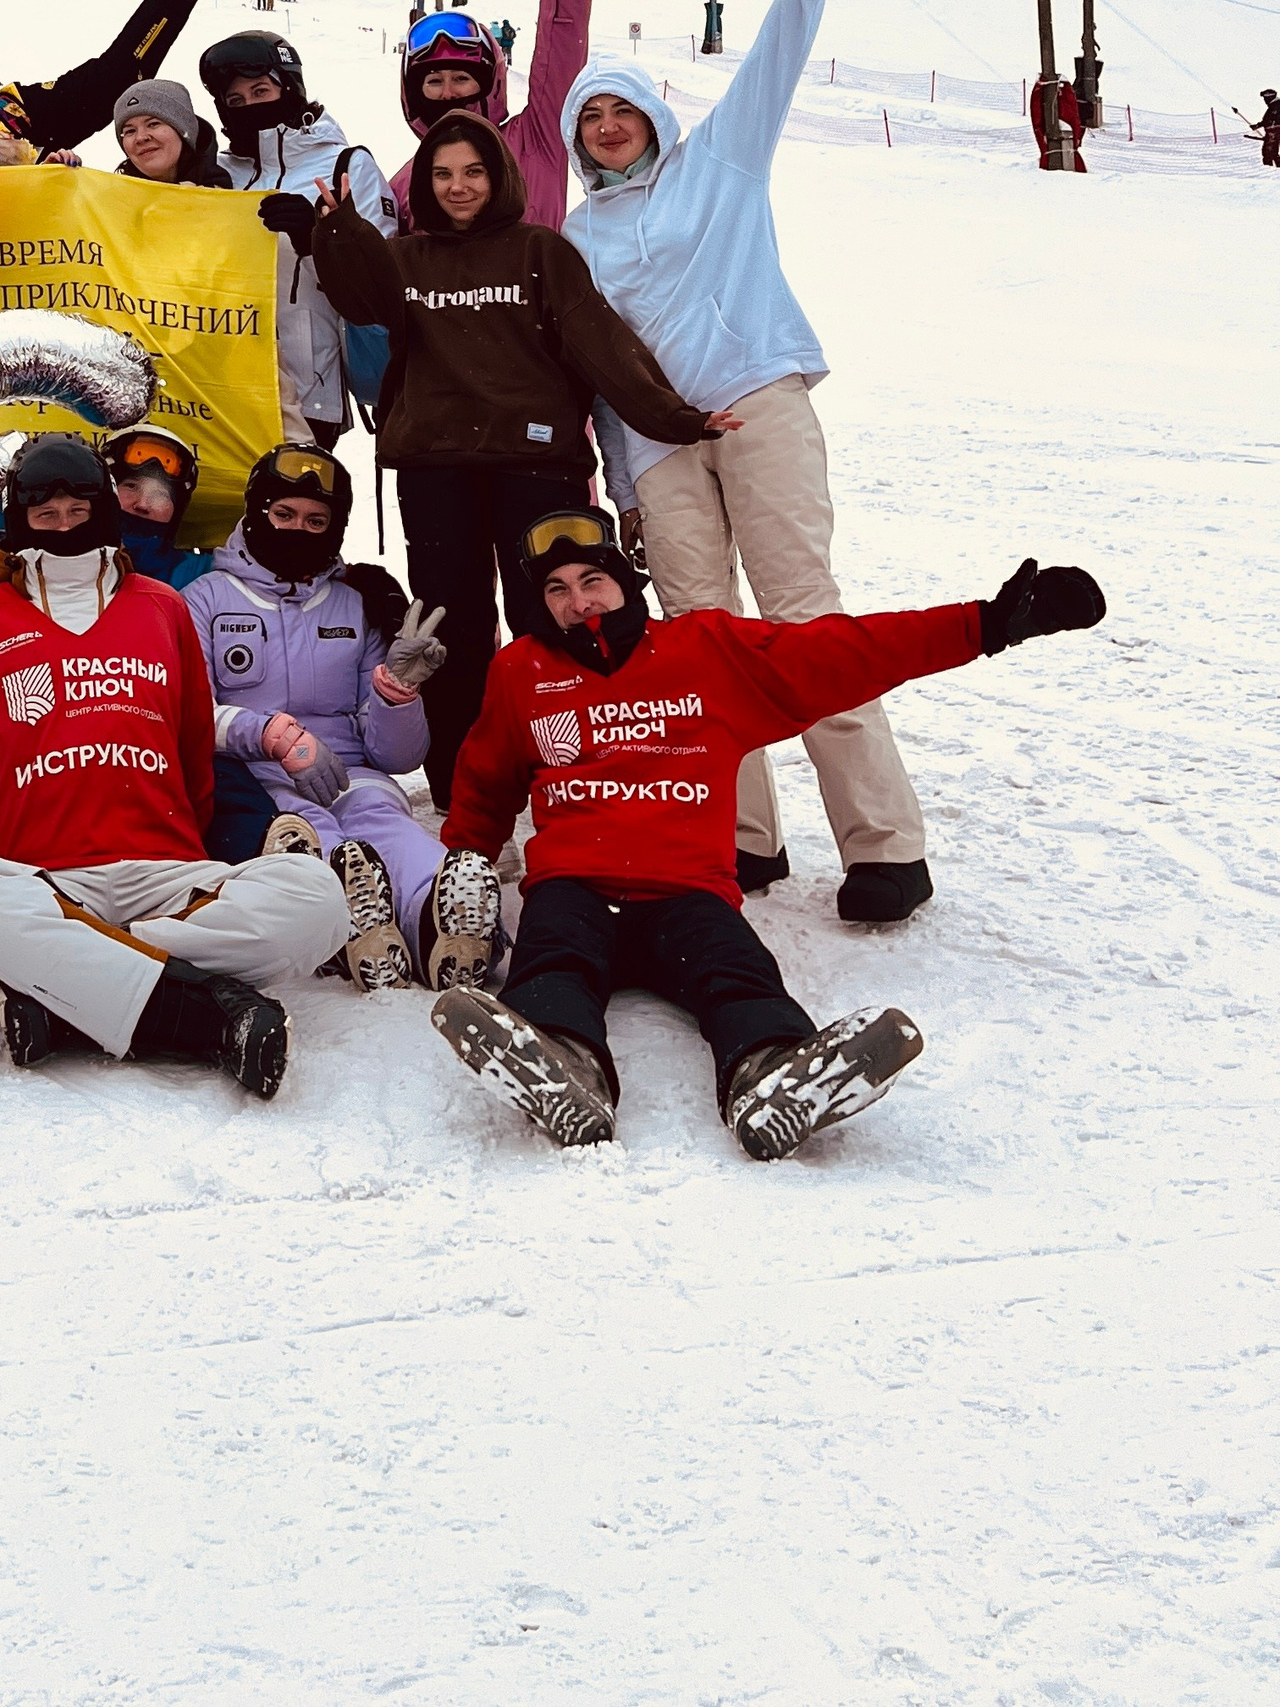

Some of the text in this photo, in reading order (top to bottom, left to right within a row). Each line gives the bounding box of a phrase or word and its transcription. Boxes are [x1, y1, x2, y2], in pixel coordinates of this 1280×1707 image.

[0, 281, 260, 336] ПРИКЛЮЧЕНИЙ
[220, 623, 257, 633] HIGHEXP
[62, 657, 167, 686] КРАСНЫЙ
[65, 678, 134, 702] КЛЮЧ
[65, 707, 92, 718] ЦЕНТР
[93, 702, 140, 715] АКТИВНОГО
[588, 693, 703, 725] КРАСНЫЙ
[592, 719, 666, 745] КЛЮЧ
[15, 742, 169, 789] ИНСТРУКТОР
[596, 745, 708, 760] ЦЕНТР АКТИВНОГО ОТДЫХА
